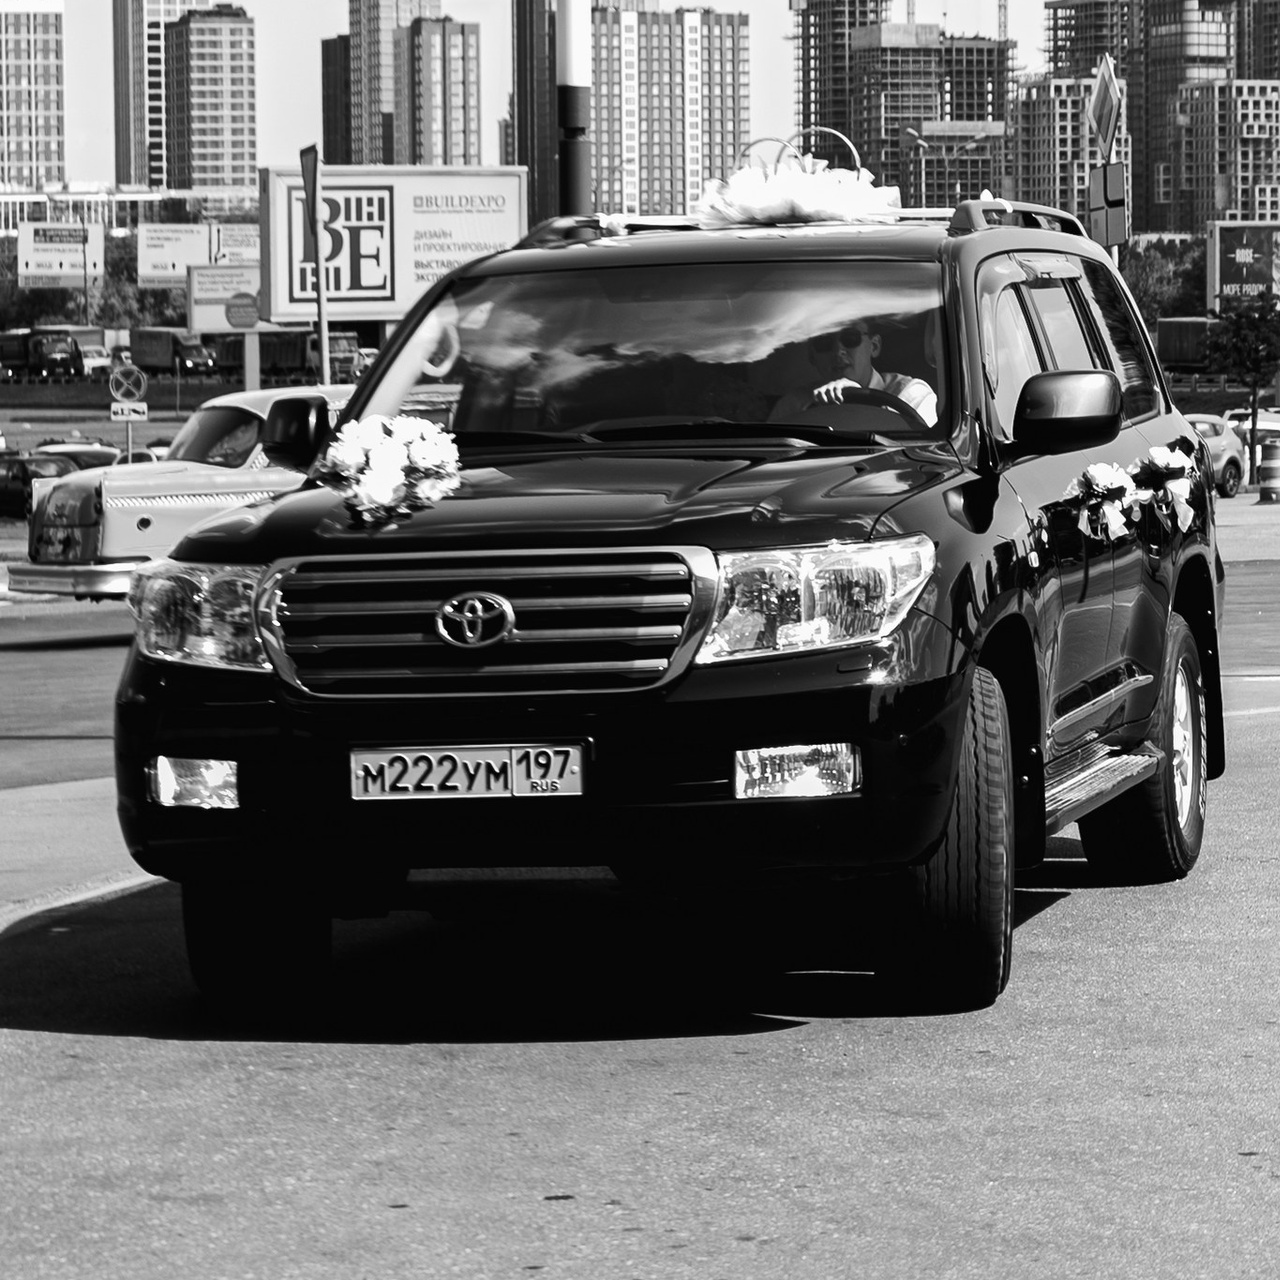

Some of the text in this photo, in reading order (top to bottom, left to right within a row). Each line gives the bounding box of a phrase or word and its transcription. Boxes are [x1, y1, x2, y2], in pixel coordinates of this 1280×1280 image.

[425, 195, 506, 208] BUILDEXPO
[414, 228, 452, 240] ДИЗАЙН
[414, 243, 421, 252] И
[1235, 248, 1254, 263] ROSE
[1223, 284, 1241, 296] МОРЕ
[516, 748, 572, 780] 197
[530, 779, 560, 792] RUS
